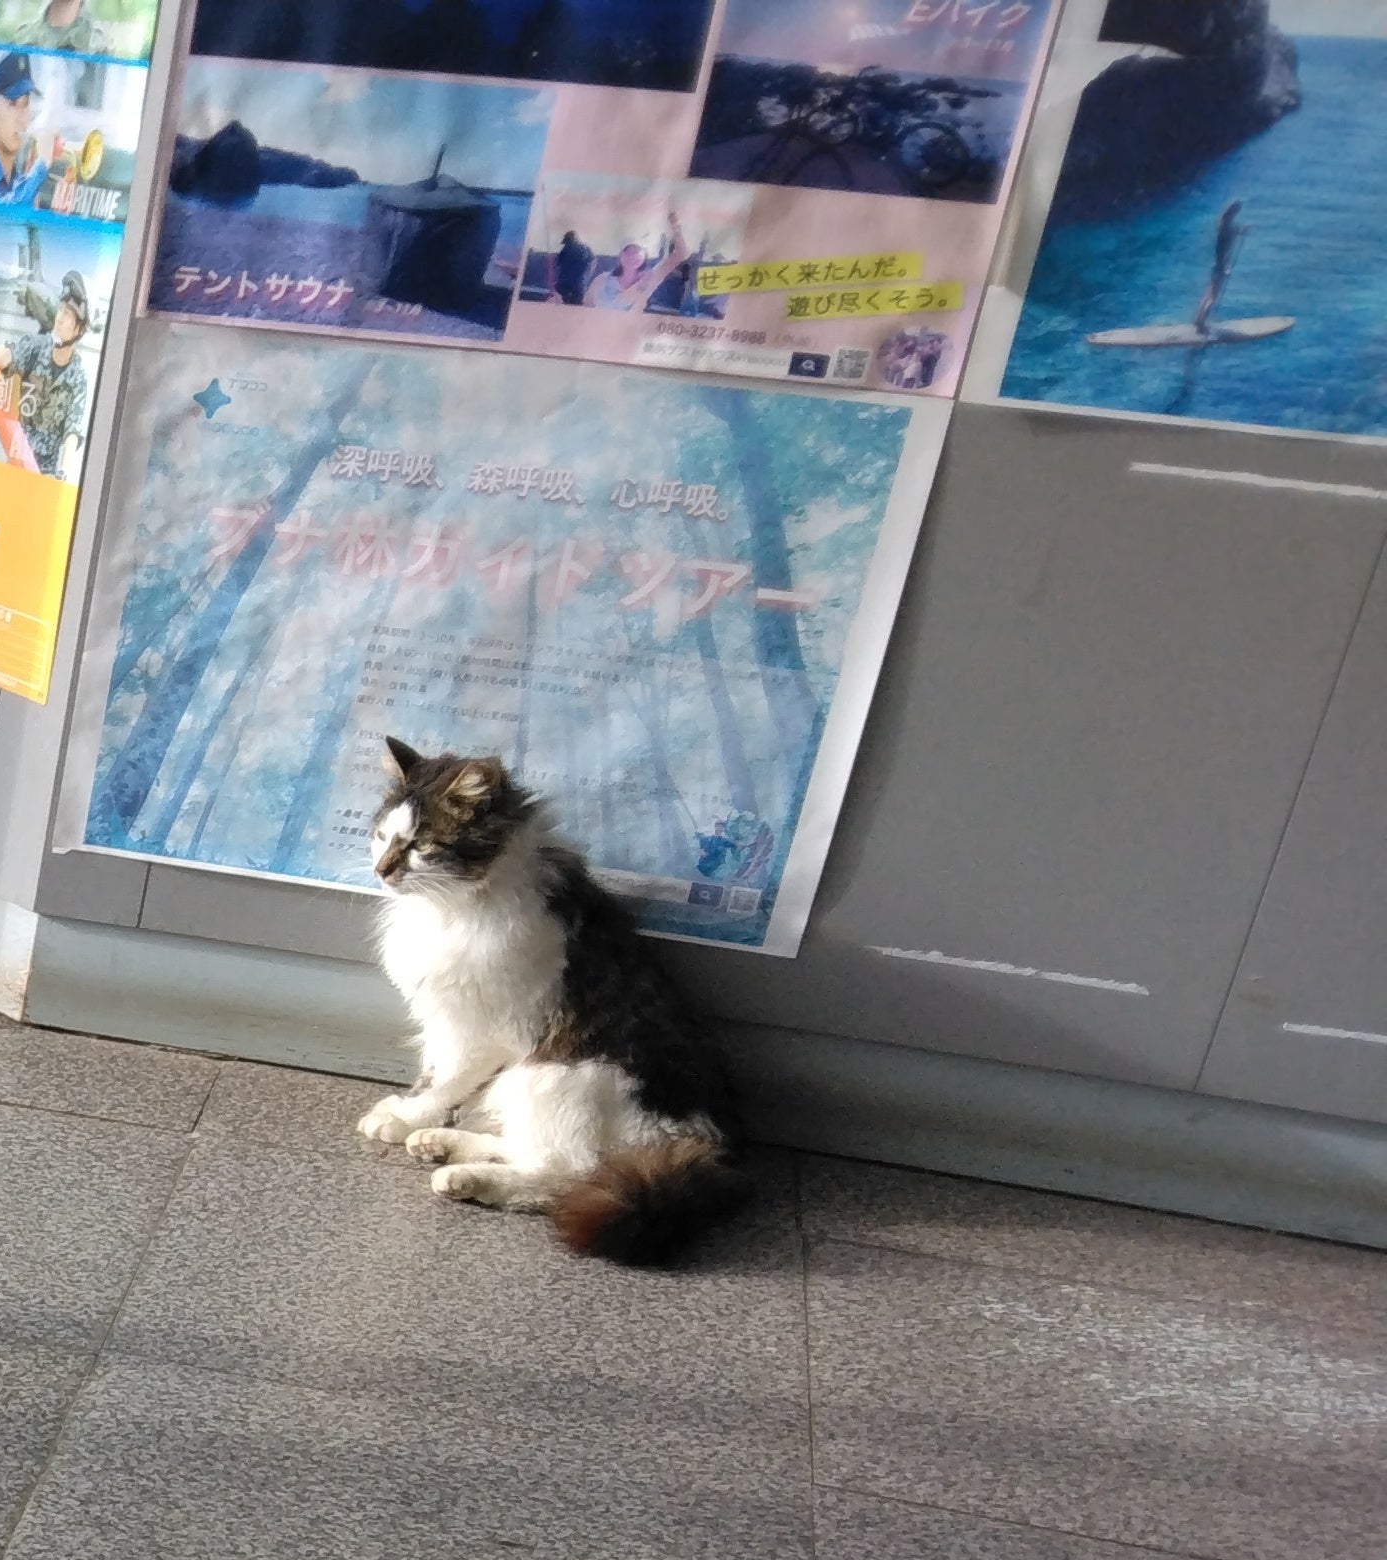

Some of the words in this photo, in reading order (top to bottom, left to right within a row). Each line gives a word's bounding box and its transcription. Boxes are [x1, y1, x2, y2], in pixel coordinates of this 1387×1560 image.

[174, 265, 355, 309] テントサウナ
[699, 255, 908, 290] せっかく来たんだ。
[786, 287, 948, 318] 遊び尽くそう。
[203, 499, 814, 612] ブナ林ガイドツアー
